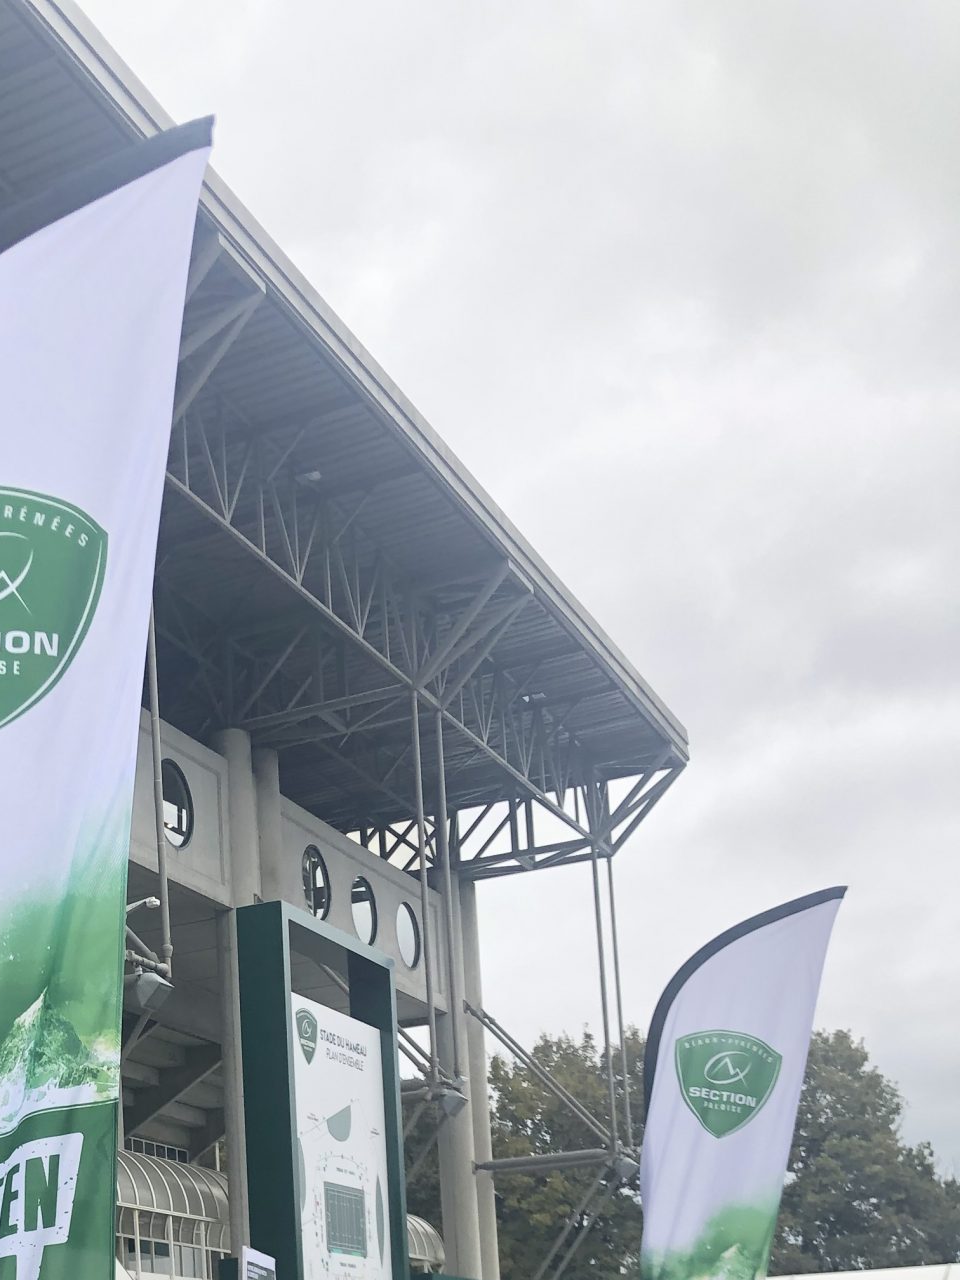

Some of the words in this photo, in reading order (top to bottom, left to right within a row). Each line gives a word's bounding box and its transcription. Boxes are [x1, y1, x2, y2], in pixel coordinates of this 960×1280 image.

[320, 1029, 336, 1046] STADE
[337, 1035, 344, 1048] DU
[688, 1086, 757, 1108] SECTION
